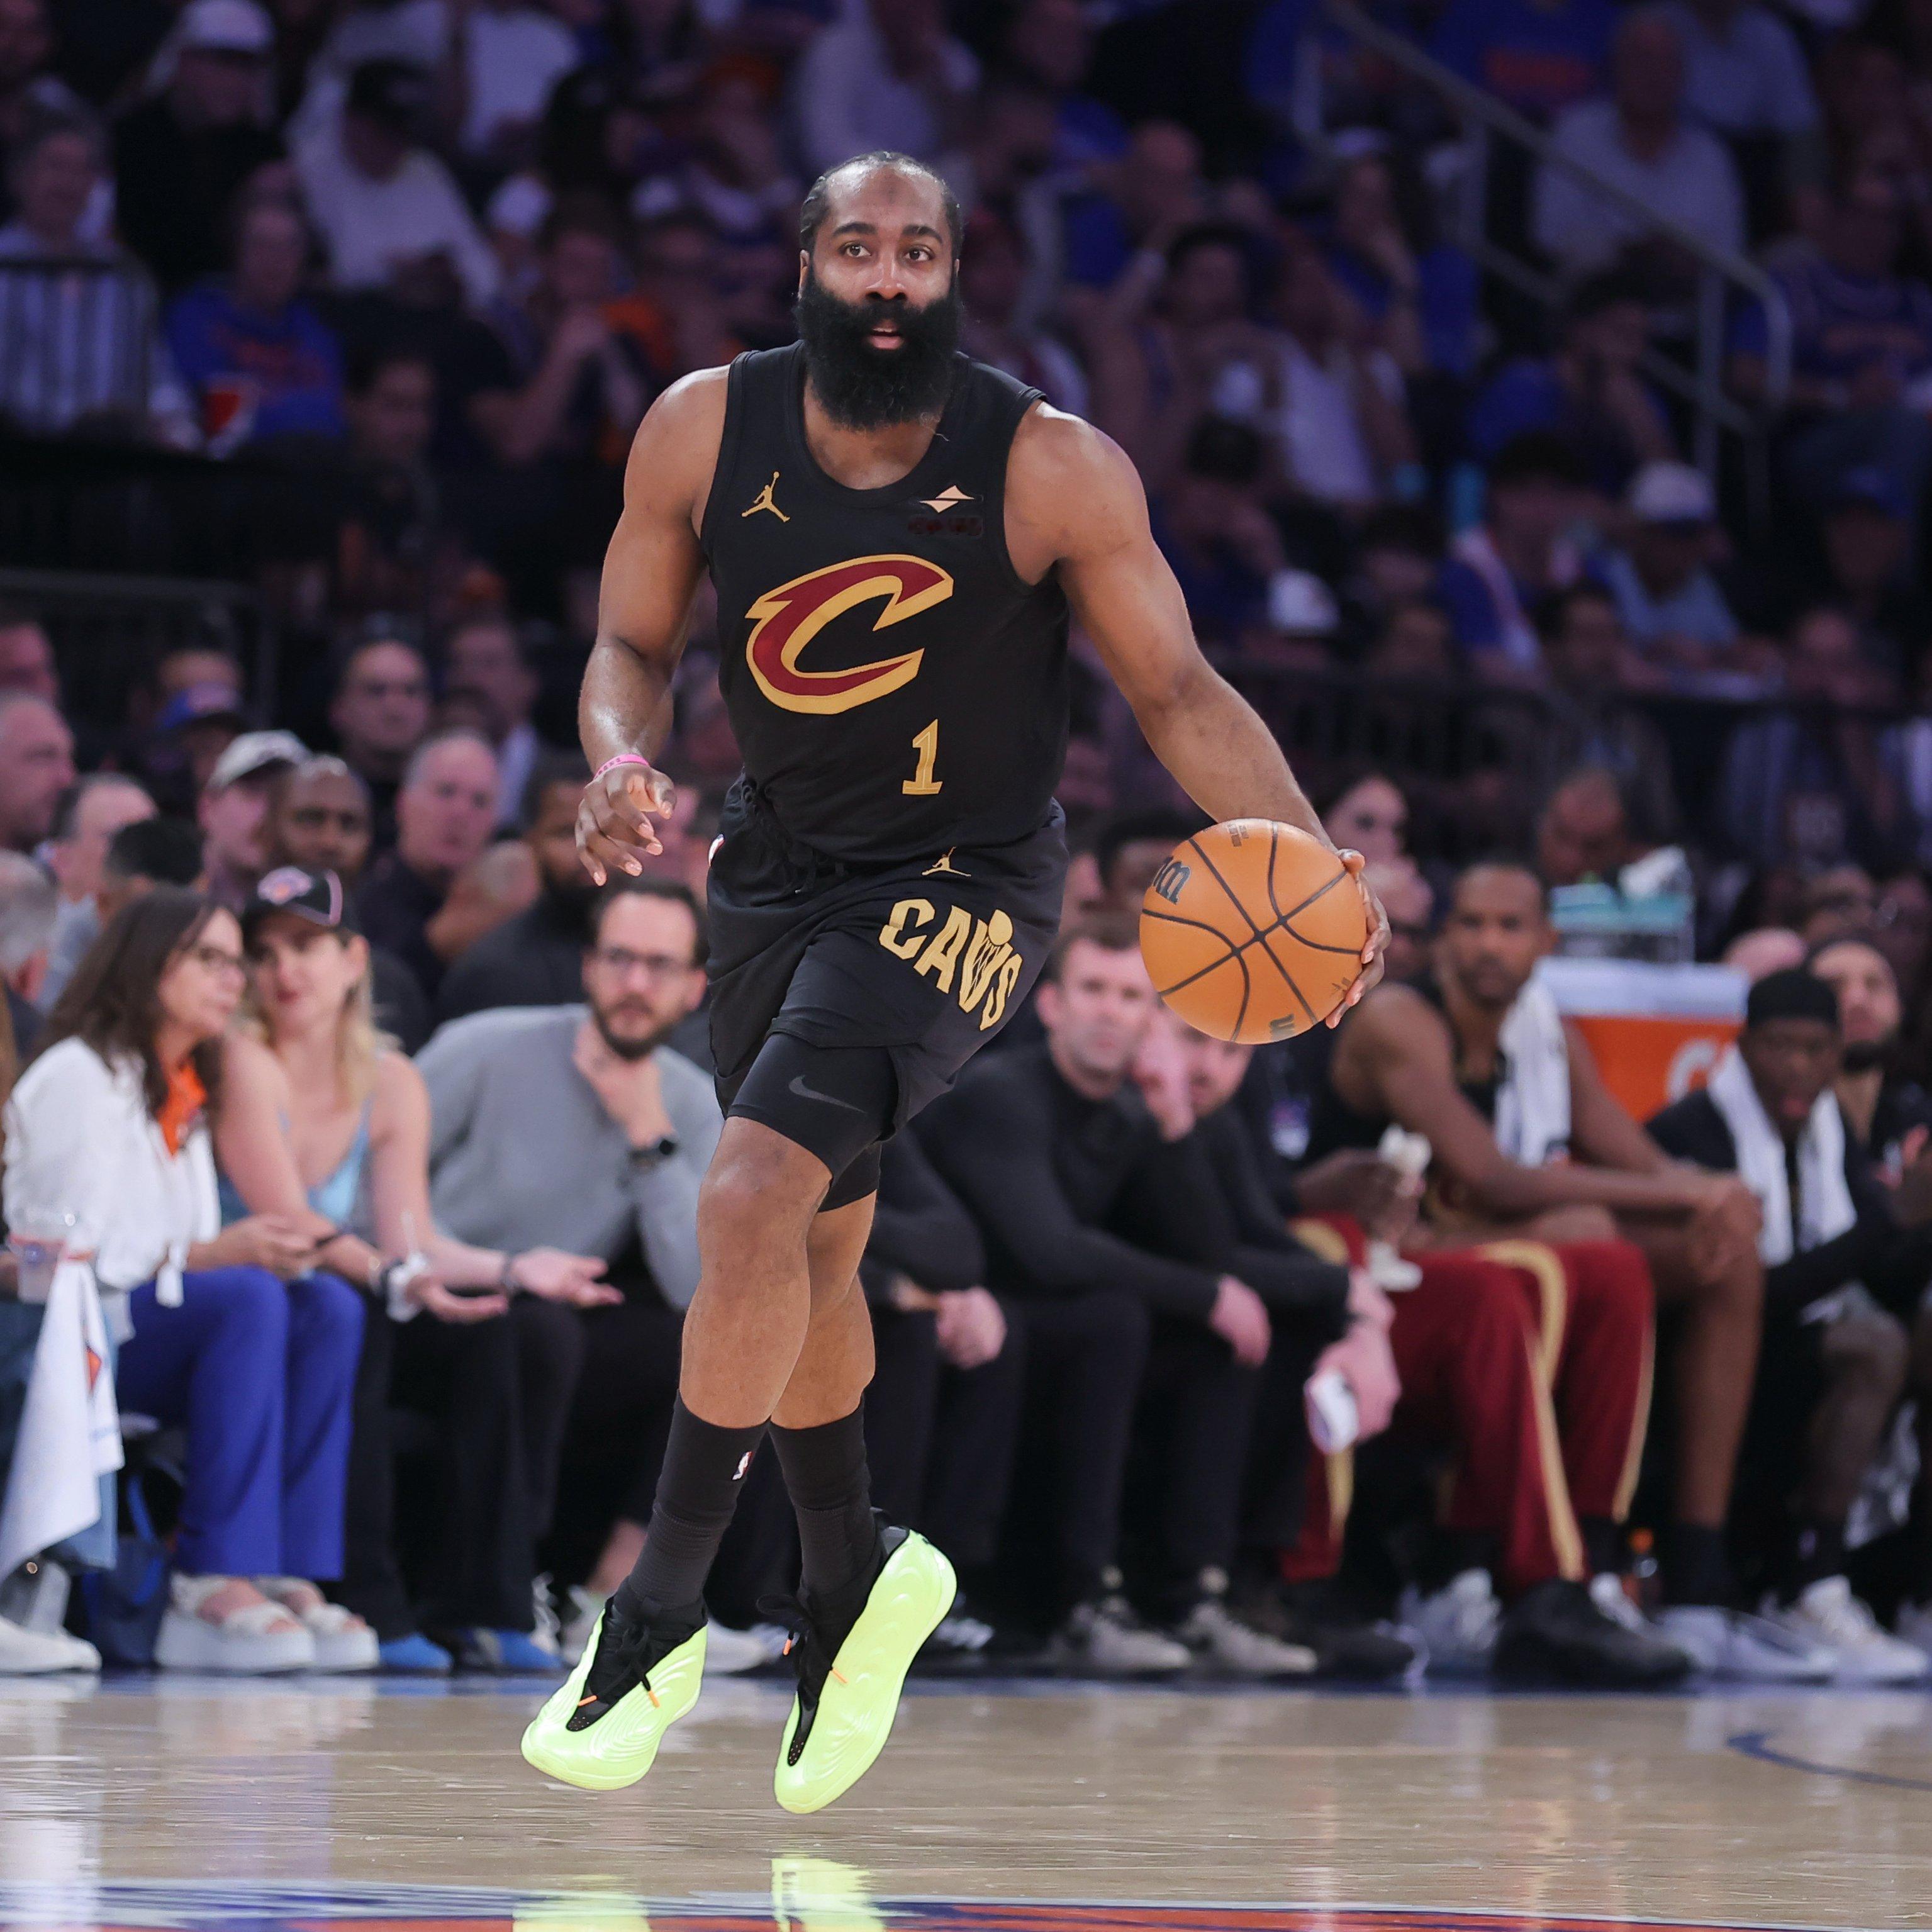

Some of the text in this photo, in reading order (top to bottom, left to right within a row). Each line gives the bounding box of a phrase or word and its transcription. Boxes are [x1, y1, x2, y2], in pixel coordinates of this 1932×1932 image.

[745, 554, 954, 715] C
[902, 719, 942, 795] 1
[879, 899, 1022, 1030] CAVS
